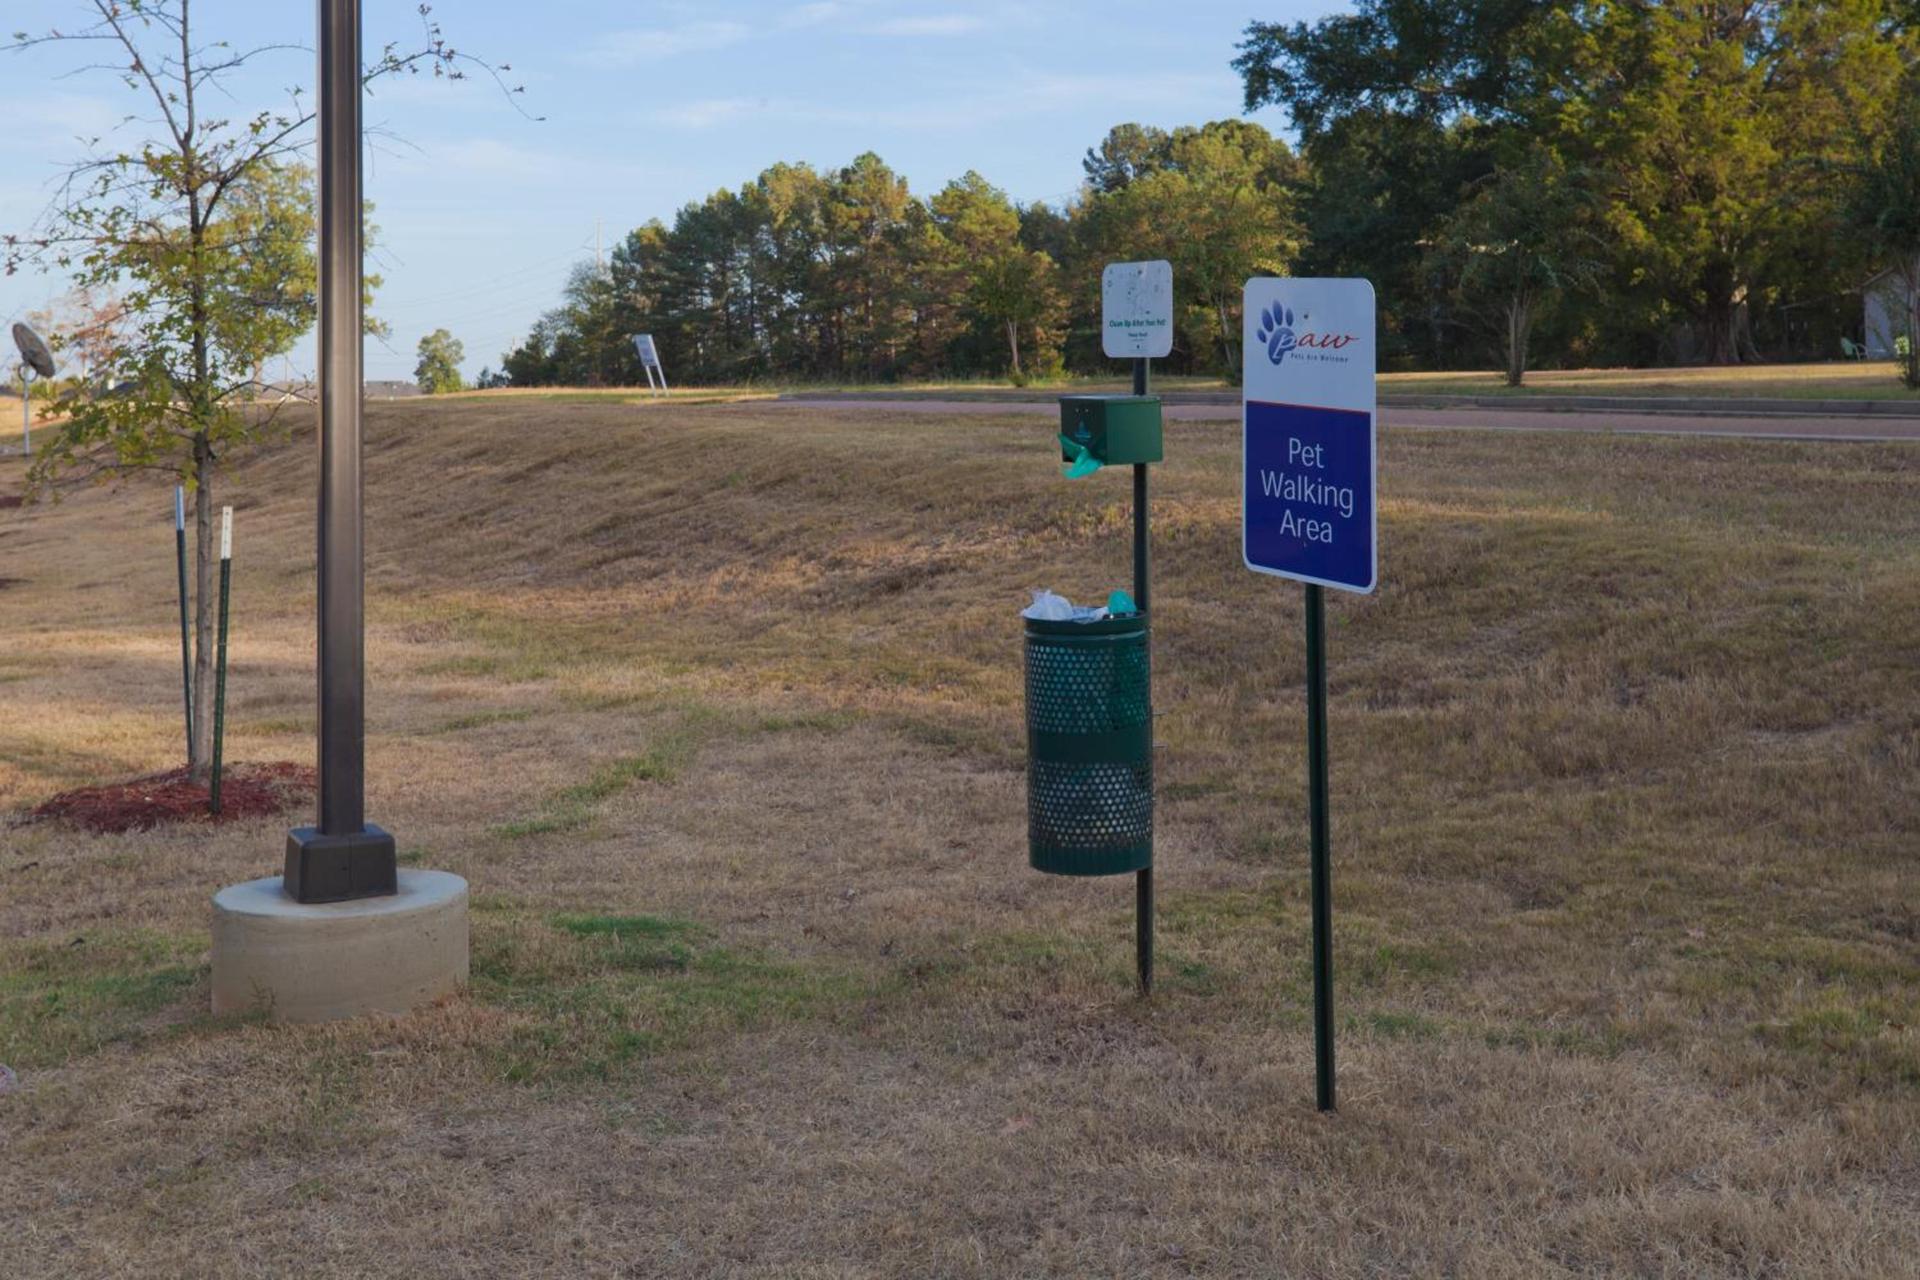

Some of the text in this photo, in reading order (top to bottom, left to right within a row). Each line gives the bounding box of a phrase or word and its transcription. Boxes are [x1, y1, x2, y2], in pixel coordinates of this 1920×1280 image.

[1291, 352, 1304, 360] Pets
[1320, 354, 1348, 363] Welcome
[1288, 437, 1325, 469] Pet
[1261, 469, 1353, 518] Walking
[1280, 509, 1333, 543] Area
